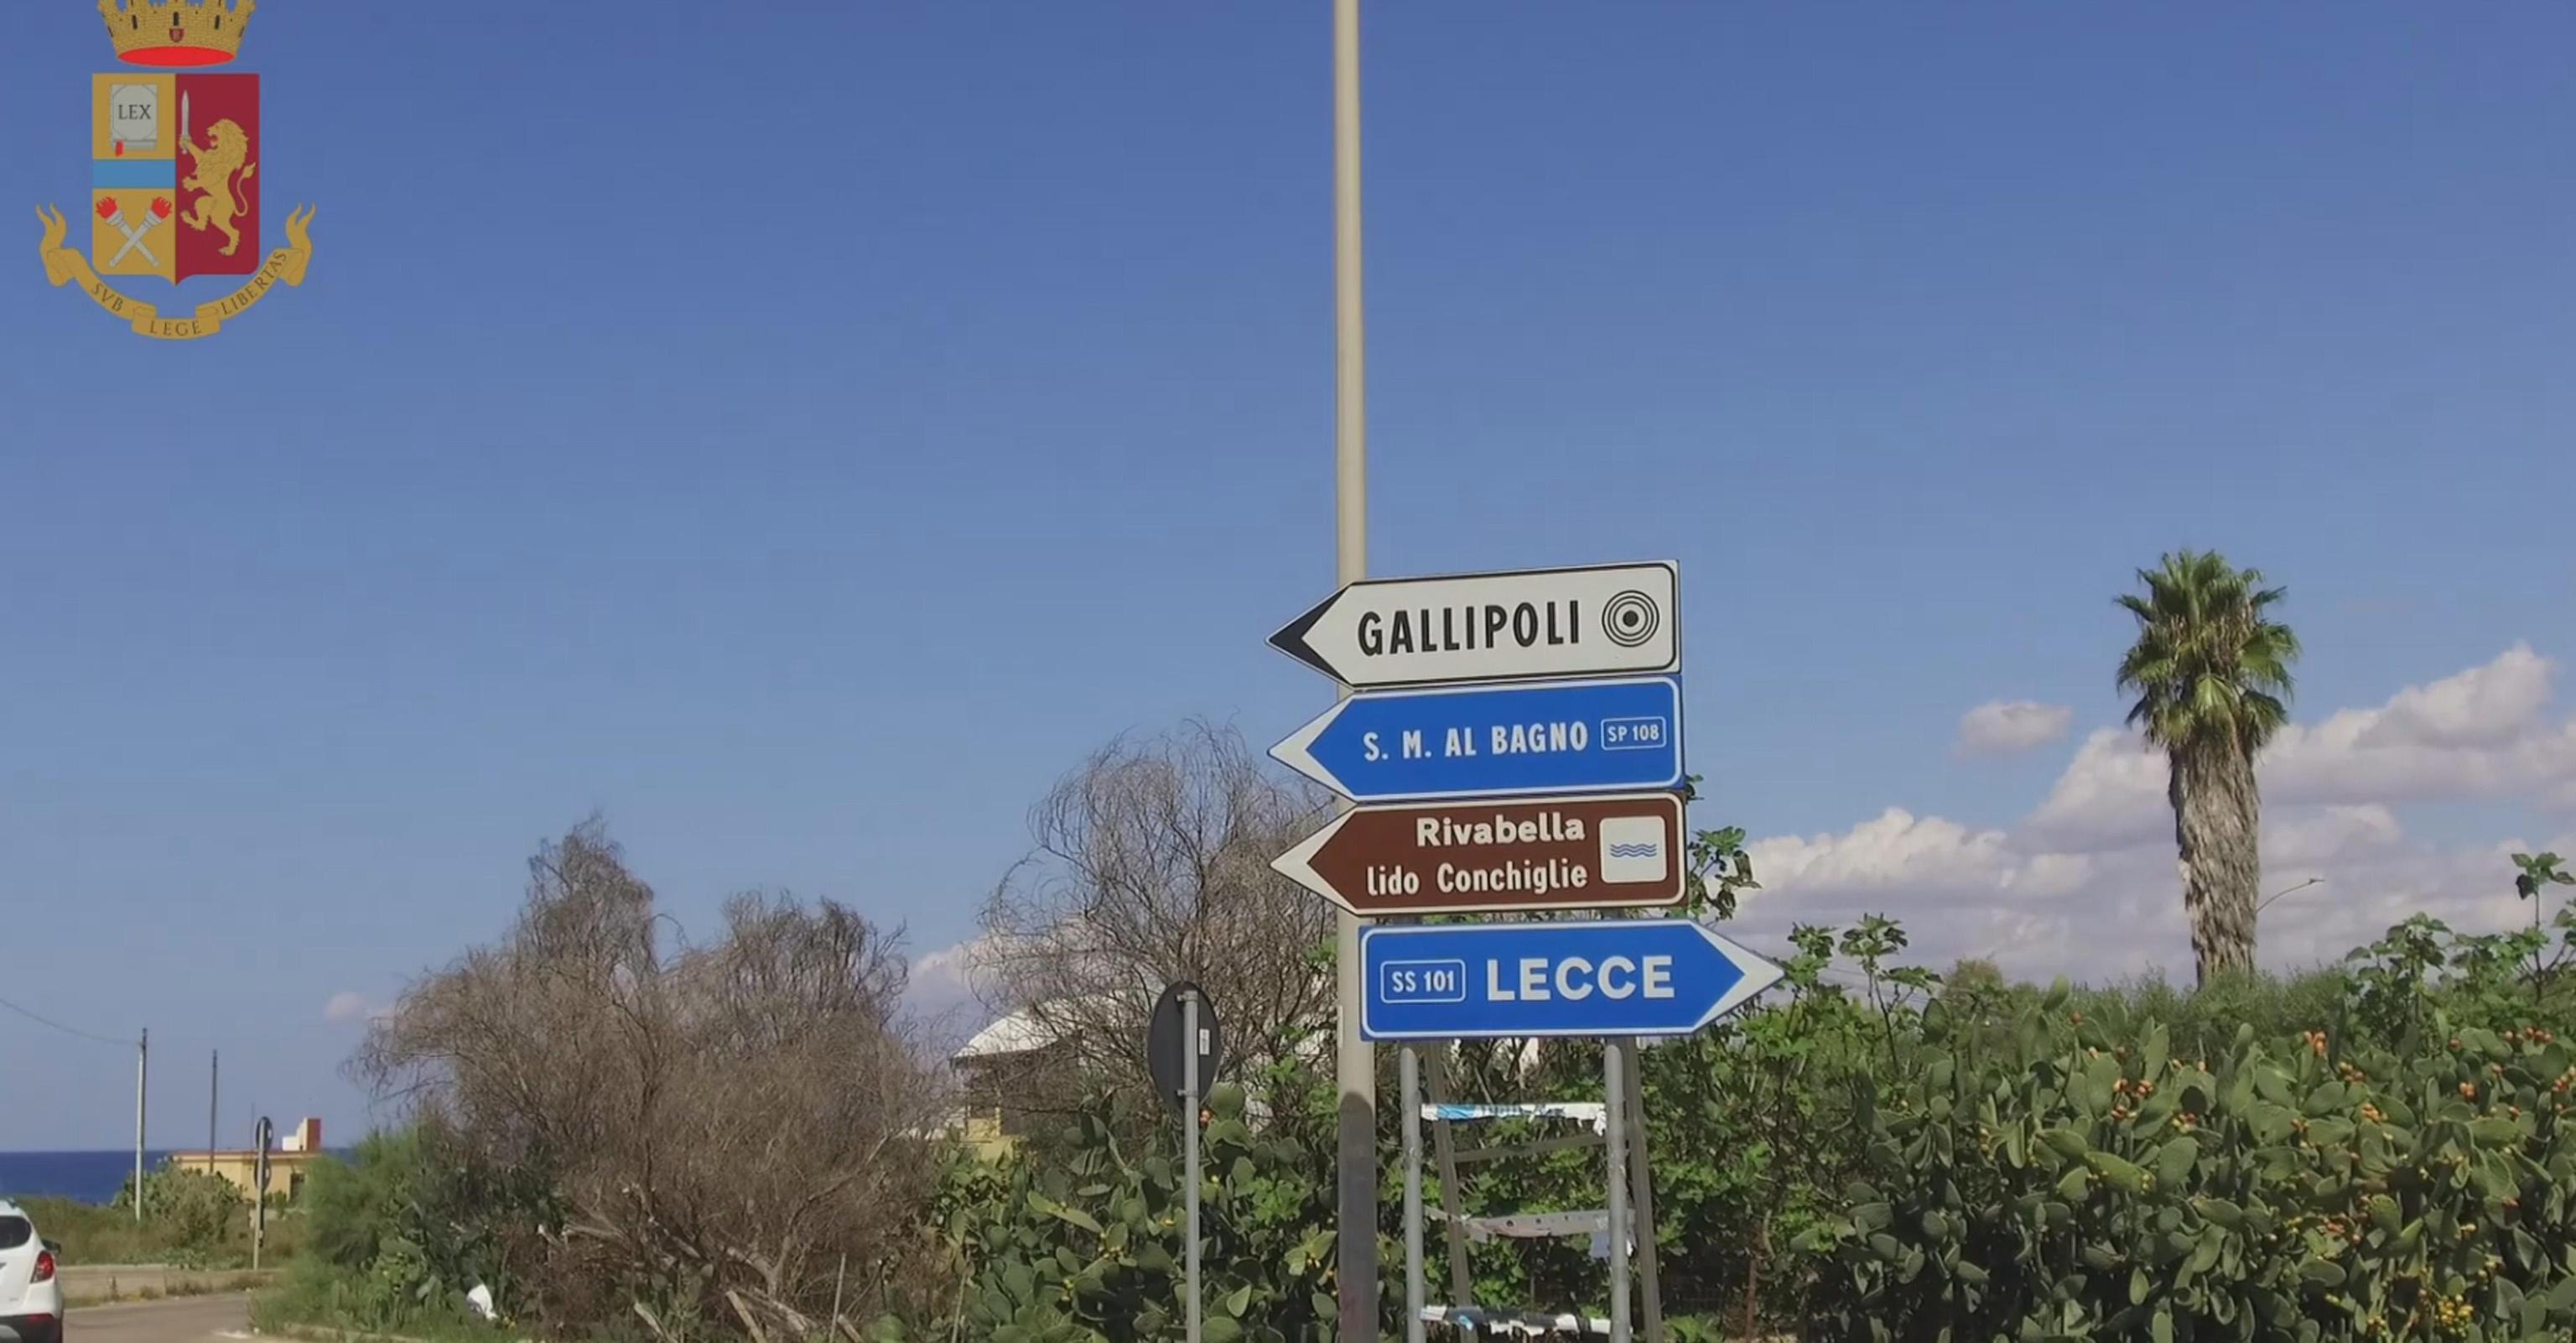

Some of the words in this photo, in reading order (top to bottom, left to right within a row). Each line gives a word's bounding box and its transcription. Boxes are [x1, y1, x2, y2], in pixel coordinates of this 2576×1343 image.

[1357, 599, 1581, 657] GALLIPOLI
[1363, 731, 1389, 762] S.
[1403, 730, 1432, 759] M.
[1445, 727, 1477, 757] AL
[1491, 721, 1589, 755] BAGNO
[1607, 726, 1628, 742] SP
[1633, 724, 1660, 742] 108
[1417, 811, 1586, 847] Rivabella
[1367, 865, 1420, 898] lido
[1437, 857, 1588, 895] Conchiglie
[1391, 971, 1416, 993] SS
[1425, 970, 1456, 992] 101
[1487, 955, 1675, 1002] LECCE
